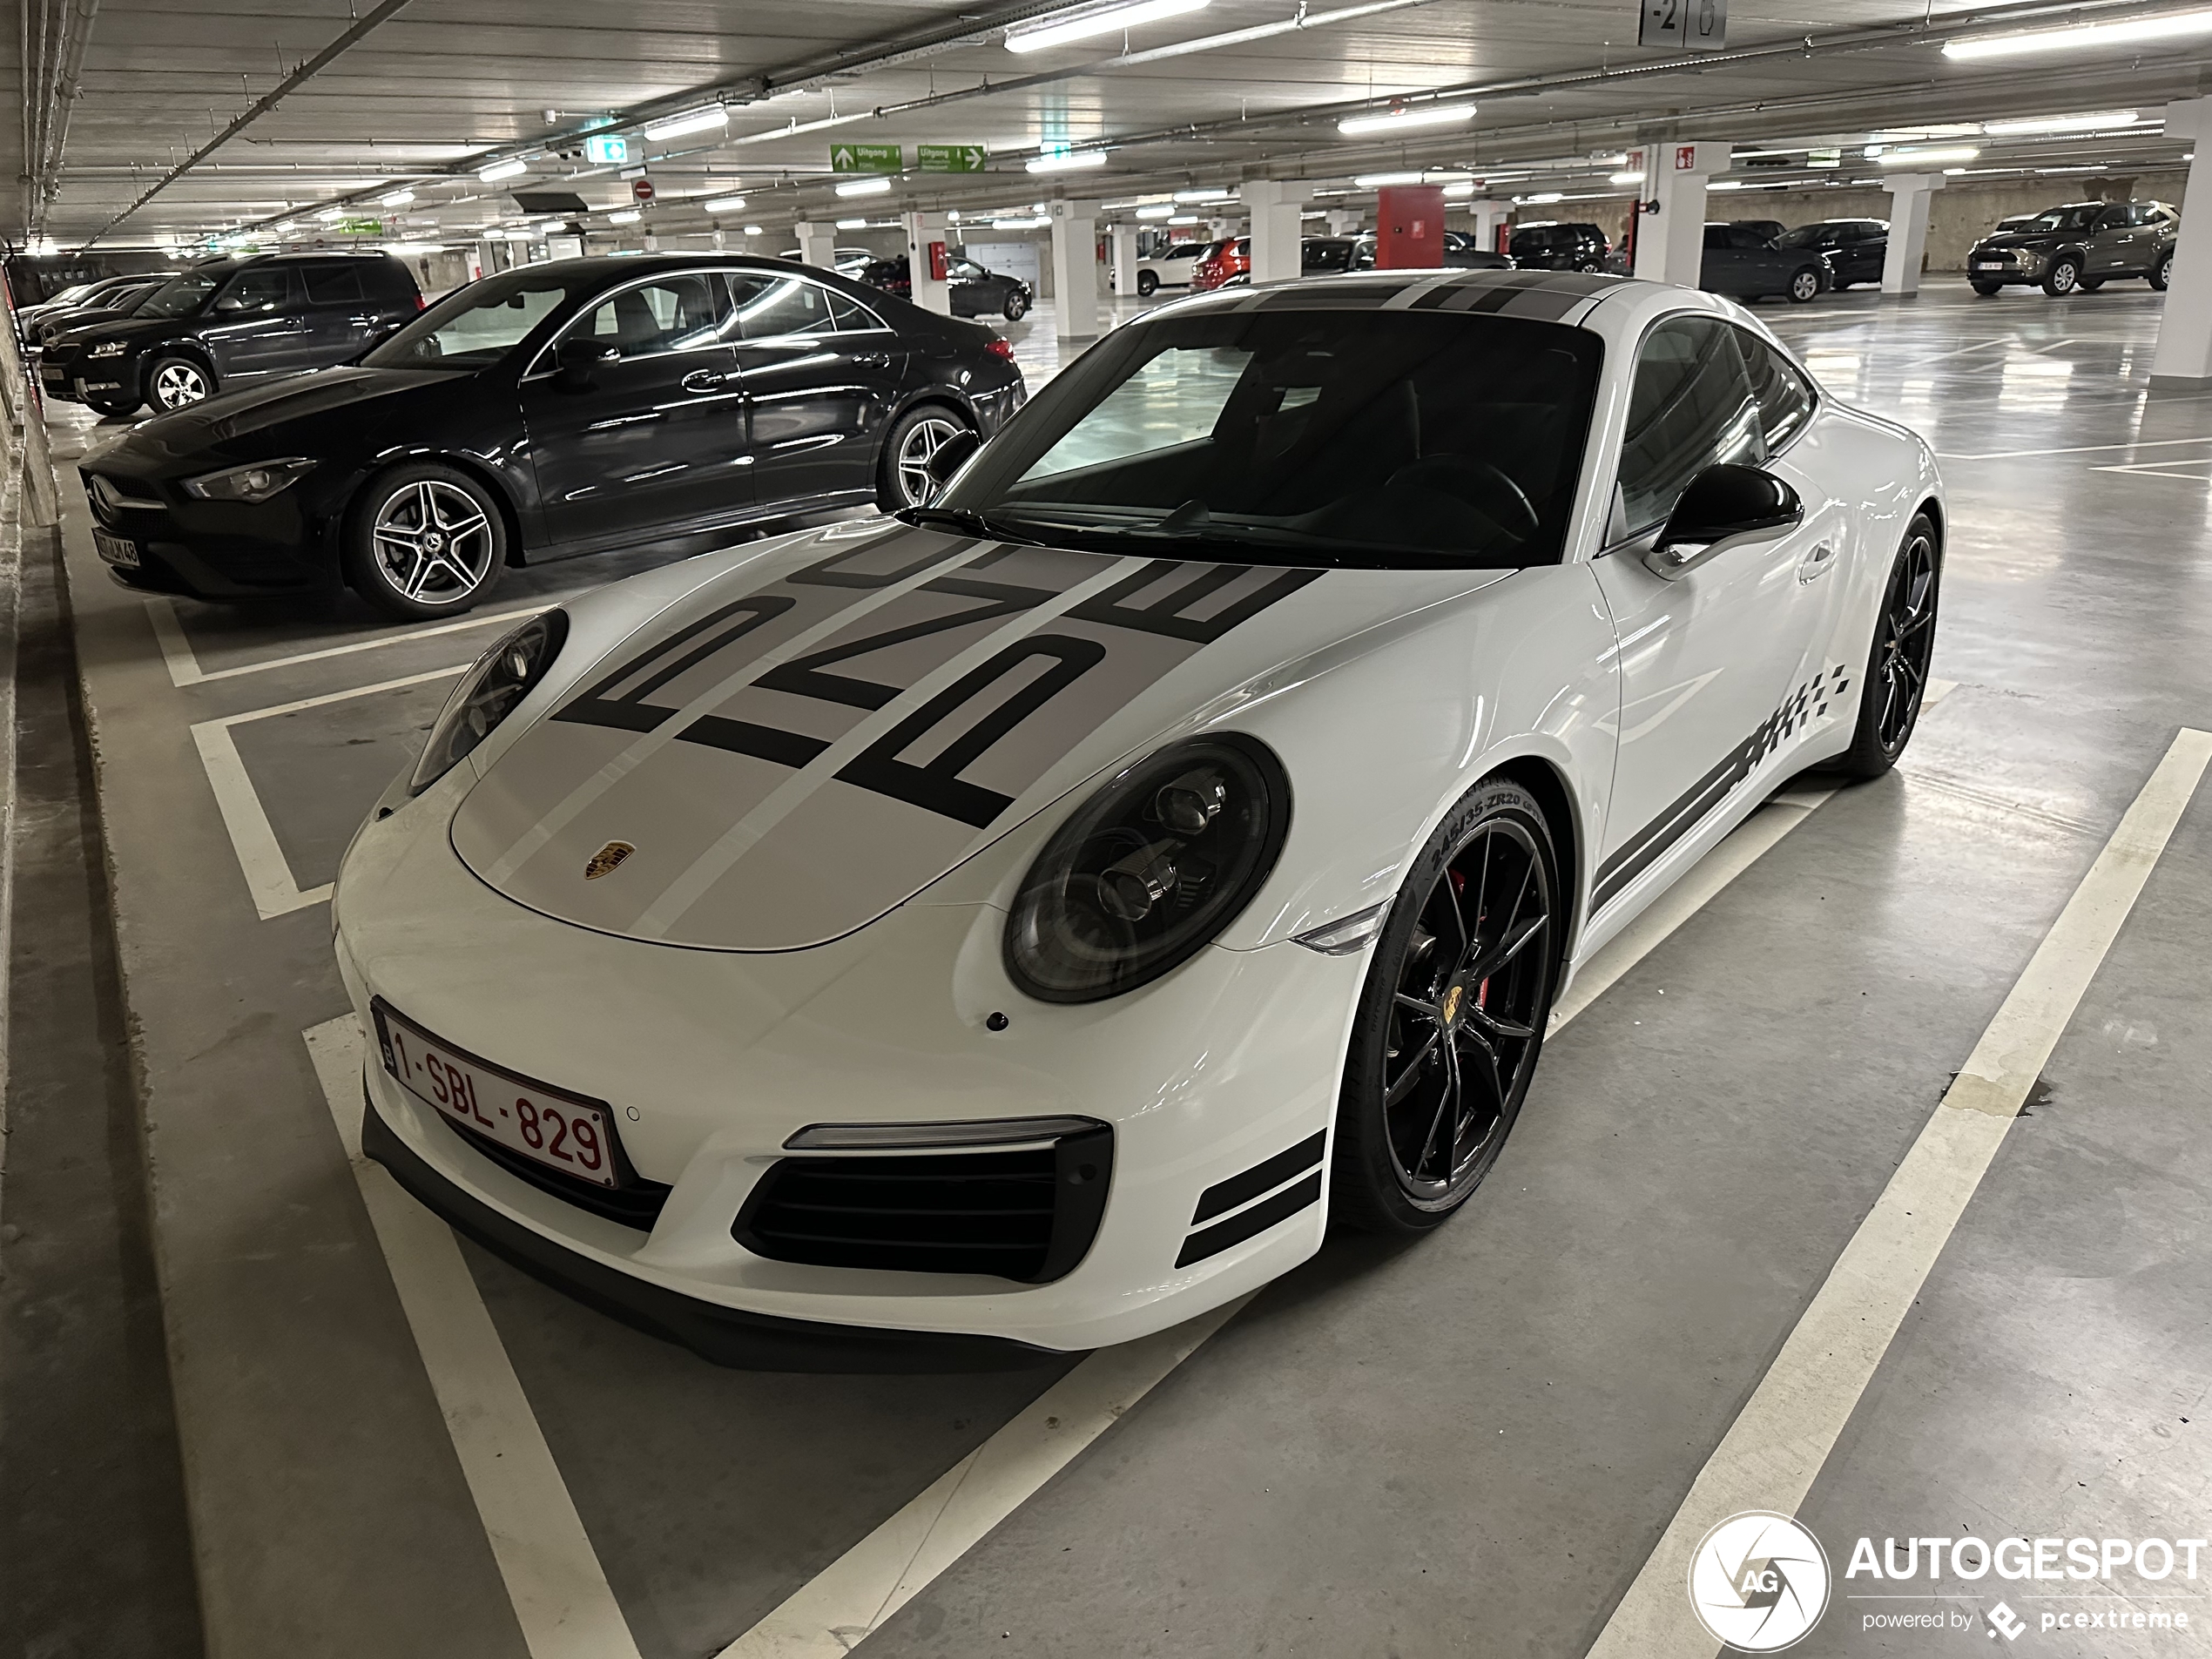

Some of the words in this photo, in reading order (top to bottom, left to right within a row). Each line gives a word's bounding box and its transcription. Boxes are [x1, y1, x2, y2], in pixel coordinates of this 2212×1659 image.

[1653, 0, 1677, 30] -2
[857, 147, 888, 158] Uitgang
[920, 147, 949, 158] Uitgang
[124, 542, 138, 563] 48
[1485, 792, 1521, 810] ZR20
[383, 1043, 395, 1068] B
[395, 1032, 602, 1171] 1-SBL-829
